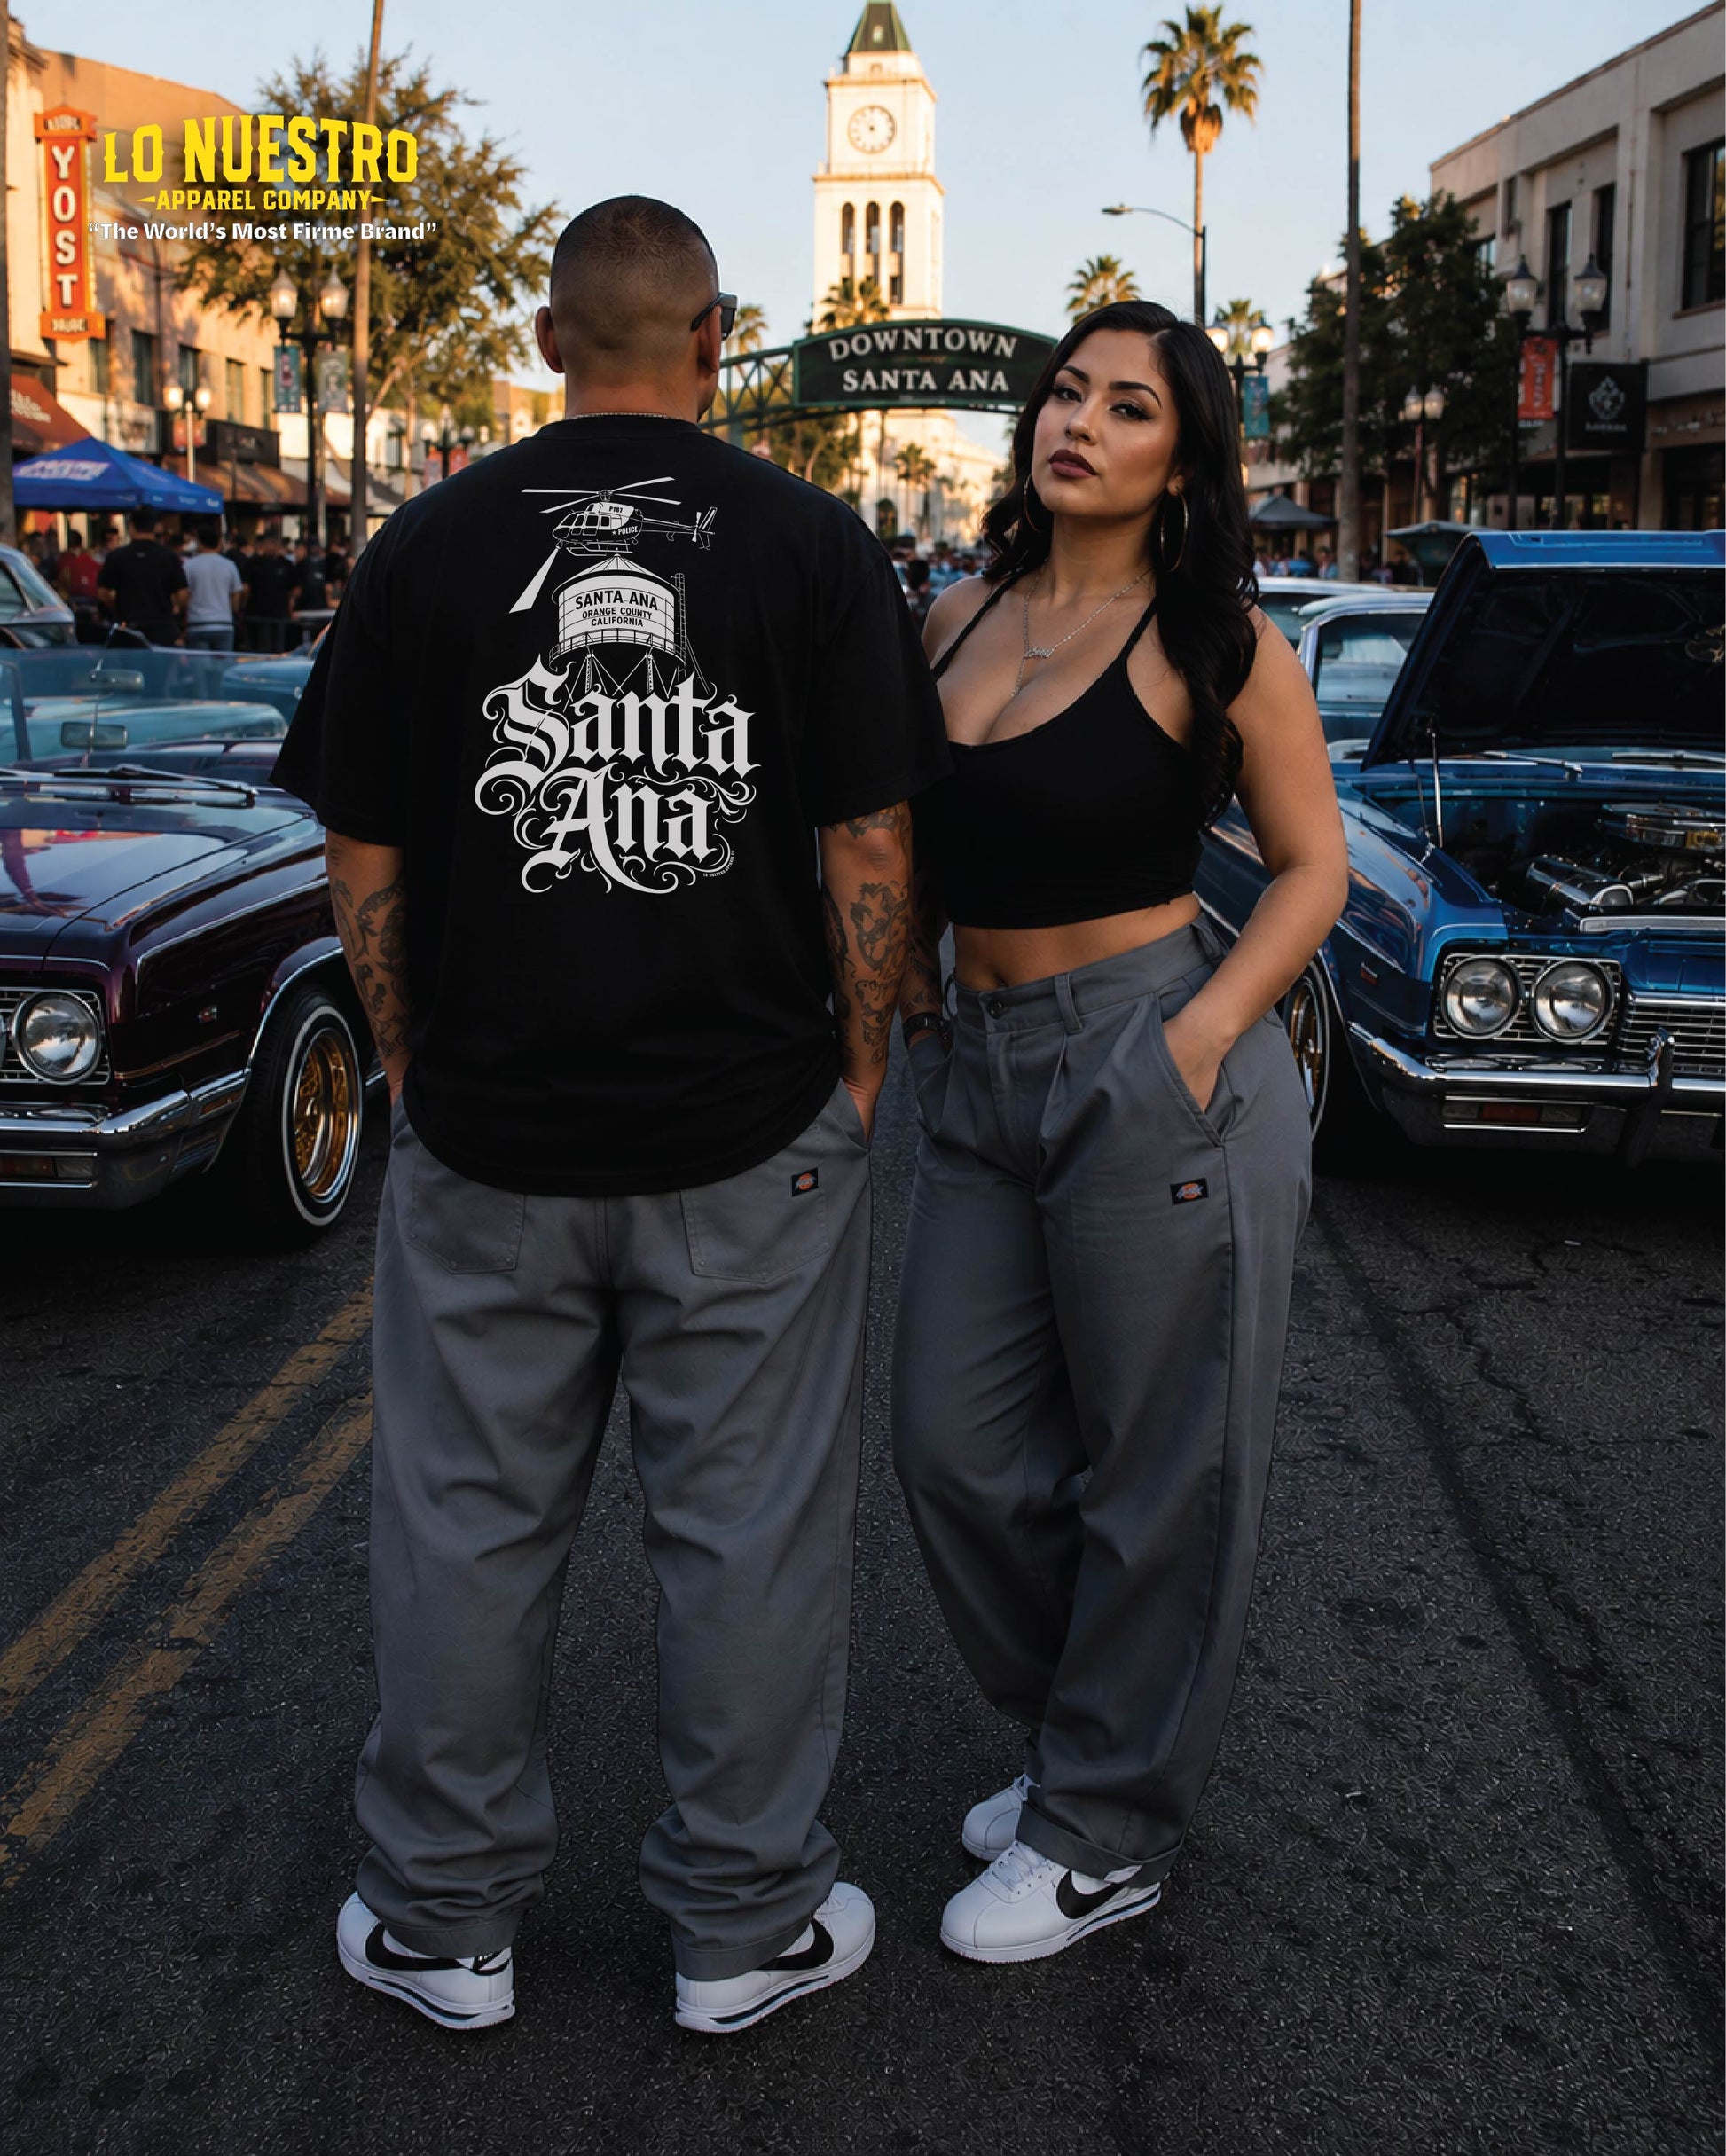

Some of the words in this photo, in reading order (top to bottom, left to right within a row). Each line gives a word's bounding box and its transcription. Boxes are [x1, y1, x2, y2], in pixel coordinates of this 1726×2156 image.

[51, 145, 78, 308] YOST
[828, 327, 1017, 362] DOWNTOWN
[843, 369, 937, 392] SANTA
[947, 370, 1009, 392] ANA
[617, 526, 639, 536] POLICE
[575, 590, 624, 610] SANTA
[629, 591, 658, 611] ANA
[582, 607, 616, 619] ORANGE
[620, 607, 652, 620] COUNTY
[591, 616, 644, 627] CALIFORNIA
[476, 654, 761, 800] Santa
[522, 762, 718, 893] Ana
